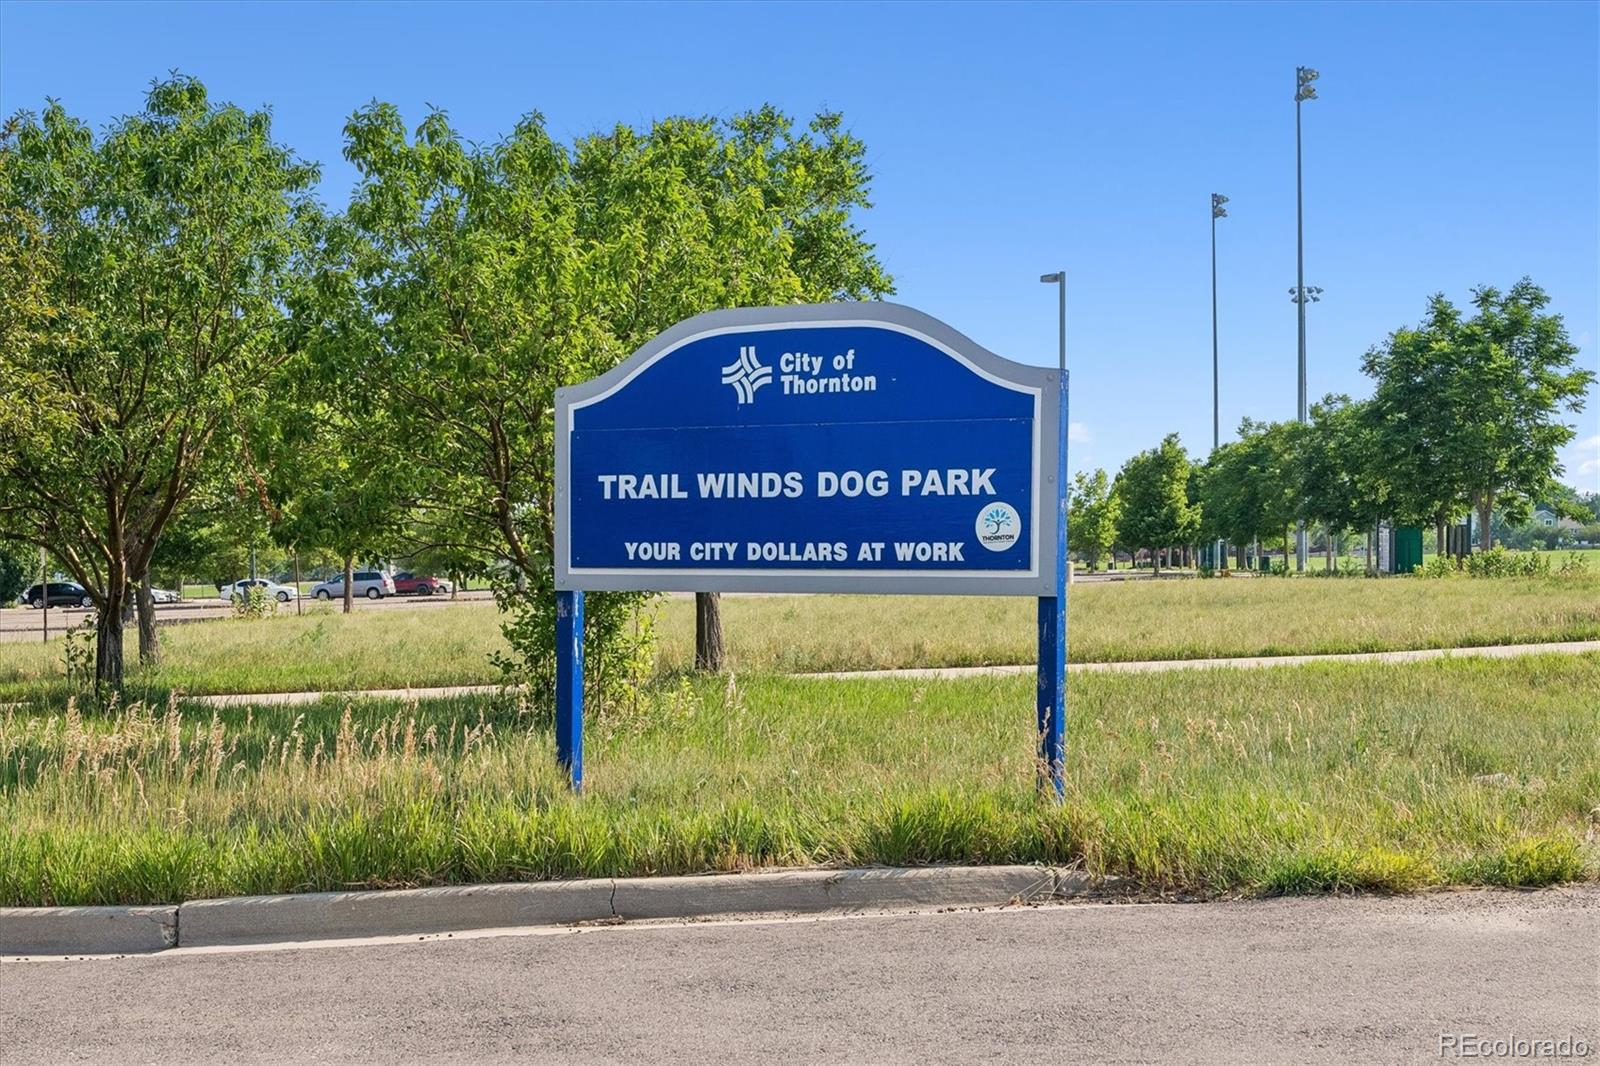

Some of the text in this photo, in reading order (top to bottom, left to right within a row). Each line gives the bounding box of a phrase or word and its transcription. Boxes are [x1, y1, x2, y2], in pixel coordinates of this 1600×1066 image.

[780, 349, 855, 376] City of
[780, 373, 877, 395] Thornton
[598, 468, 997, 500] TRAIL WINDS DOG PARK
[625, 542, 965, 562] YOUR CITY DOLLARS AT WORK
